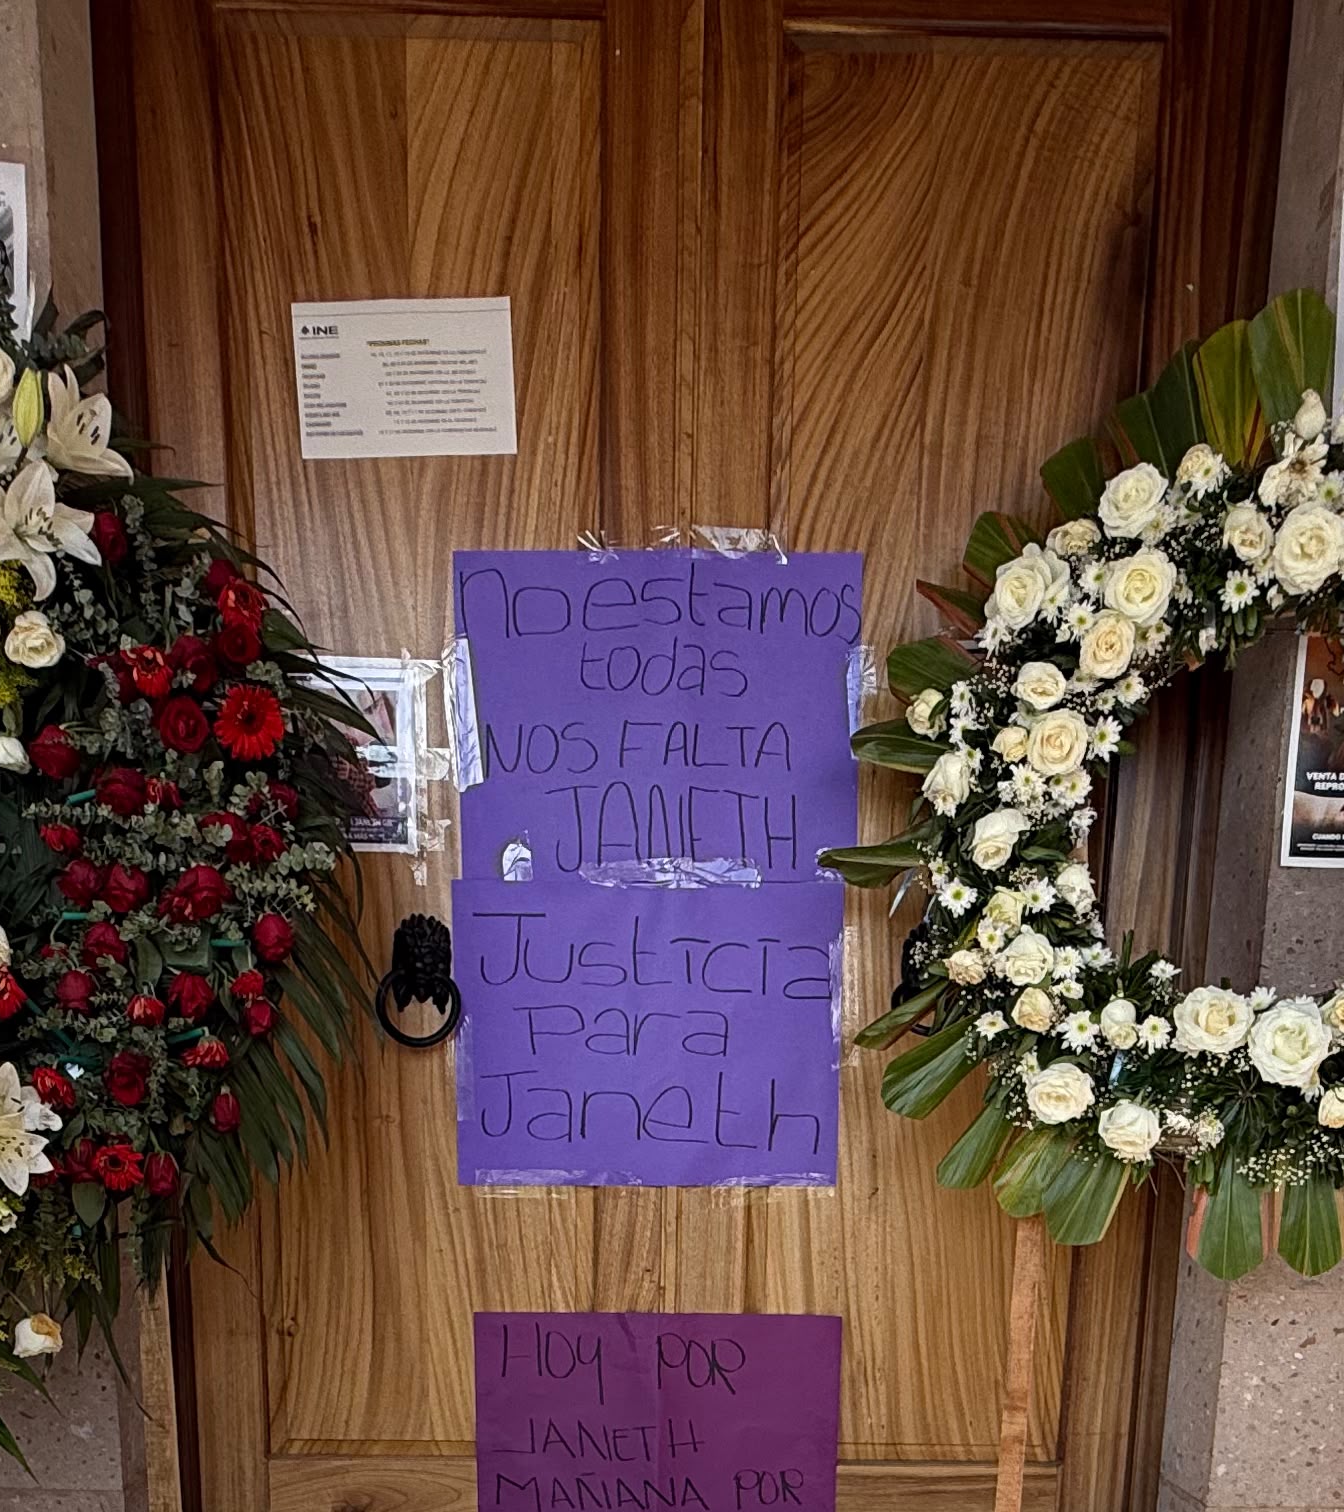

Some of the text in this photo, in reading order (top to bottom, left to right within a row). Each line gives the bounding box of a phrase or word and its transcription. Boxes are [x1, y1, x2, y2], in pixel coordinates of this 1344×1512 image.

[312, 325, 339, 336] INE
[583, 562, 862, 645] estamos
[580, 636, 748, 697] todas
[485, 720, 791, 778] NOS FALTA
[1306, 772, 1337, 781] VENTA
[545, 781, 797, 873] JANETH
[480, 1069, 821, 1154] Janeth
[501, 1321, 746, 1406] HOY POR
[491, 1417, 705, 1462] JANETH
[496, 1468, 804, 1512] MAÑANA POR
